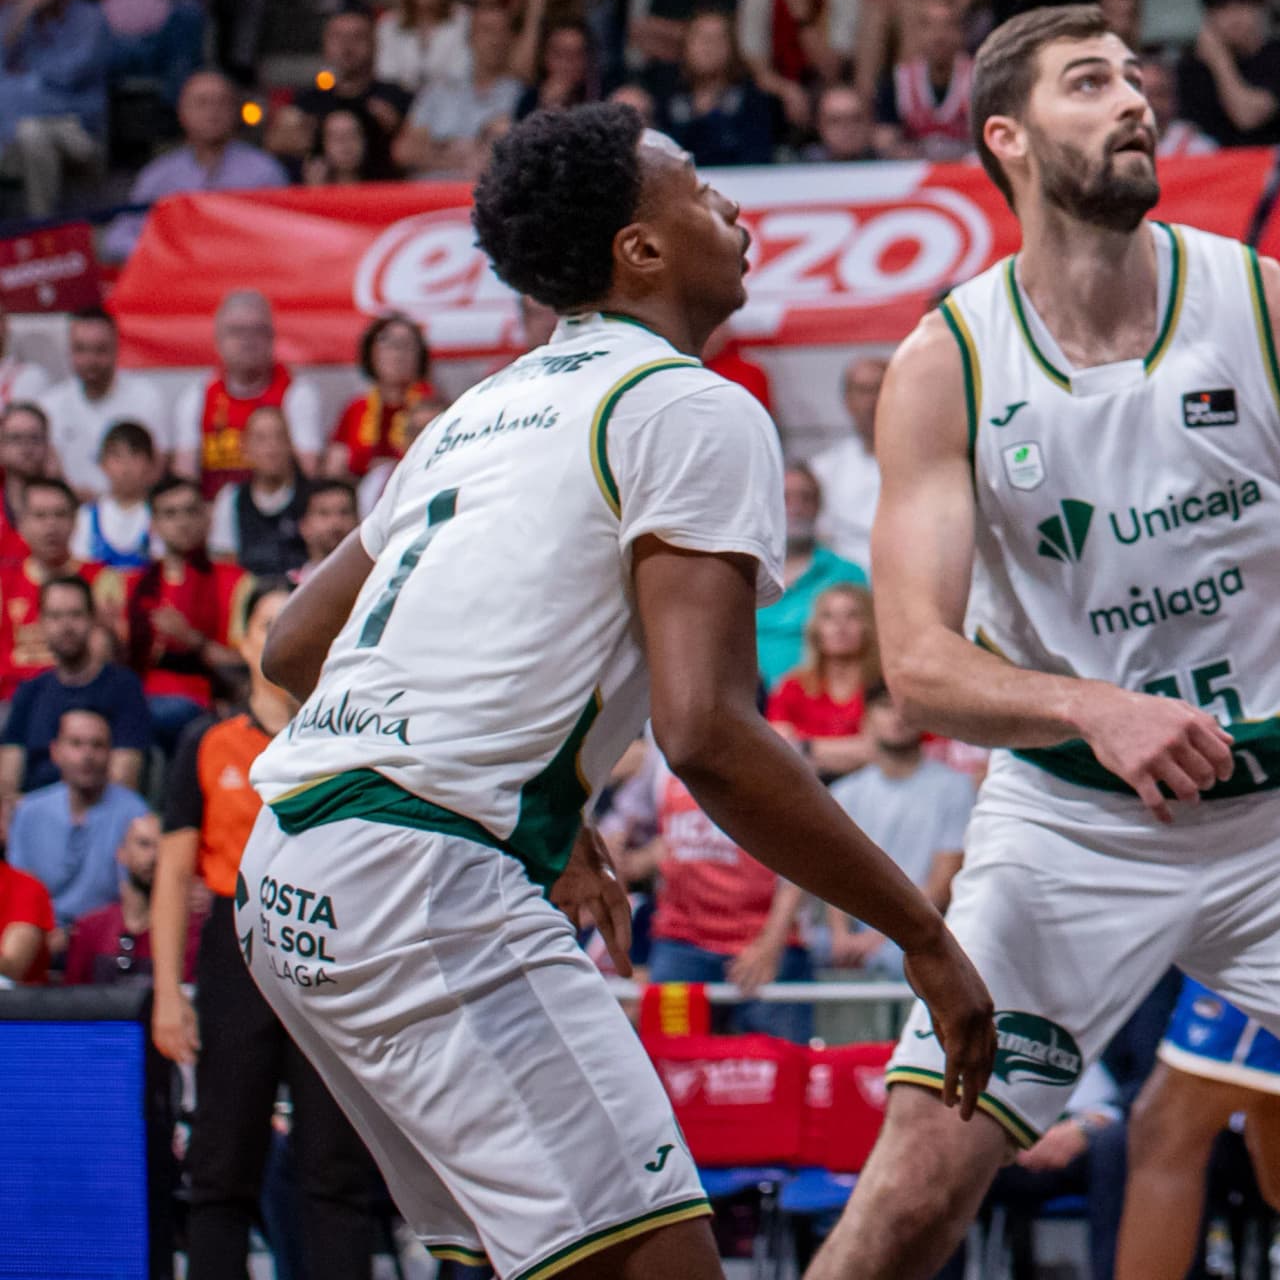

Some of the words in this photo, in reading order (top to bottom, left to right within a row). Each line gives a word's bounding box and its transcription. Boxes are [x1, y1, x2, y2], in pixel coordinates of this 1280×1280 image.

[1110, 477, 1264, 545] Unicaja
[1088, 566, 1246, 636] málaga
[288, 690, 412, 746] ndalucía
[266, 954, 338, 988] LAGA
[280, 925, 337, 964] SOL
